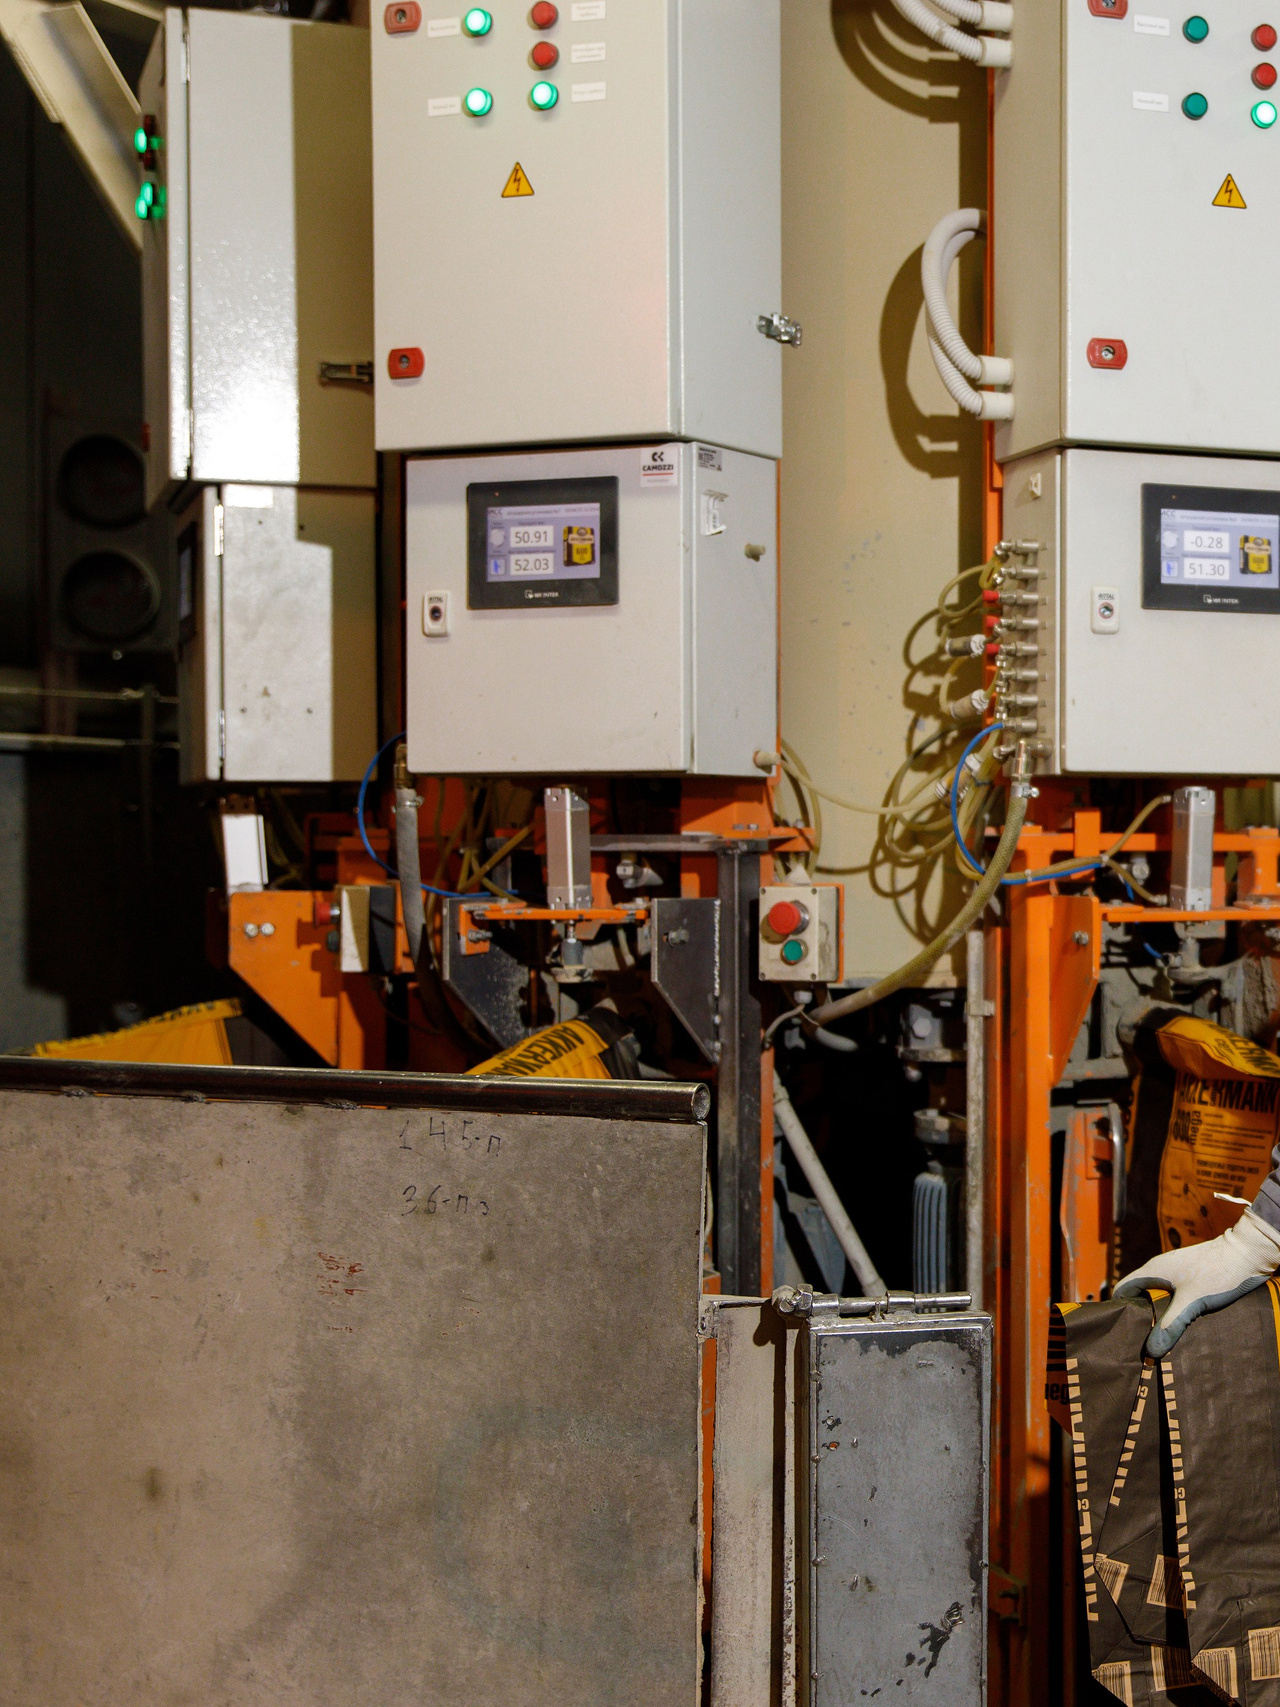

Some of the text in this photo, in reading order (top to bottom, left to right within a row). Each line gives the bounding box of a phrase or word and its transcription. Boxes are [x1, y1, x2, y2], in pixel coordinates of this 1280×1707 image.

[514, 531, 549, 544] 50.91
[1190, 536, 1224, 549] -0.28
[514, 558, 550, 571] 52.03
[1189, 563, 1225, 576] 51.30
[484, 1025, 584, 1076] AKKERMA
